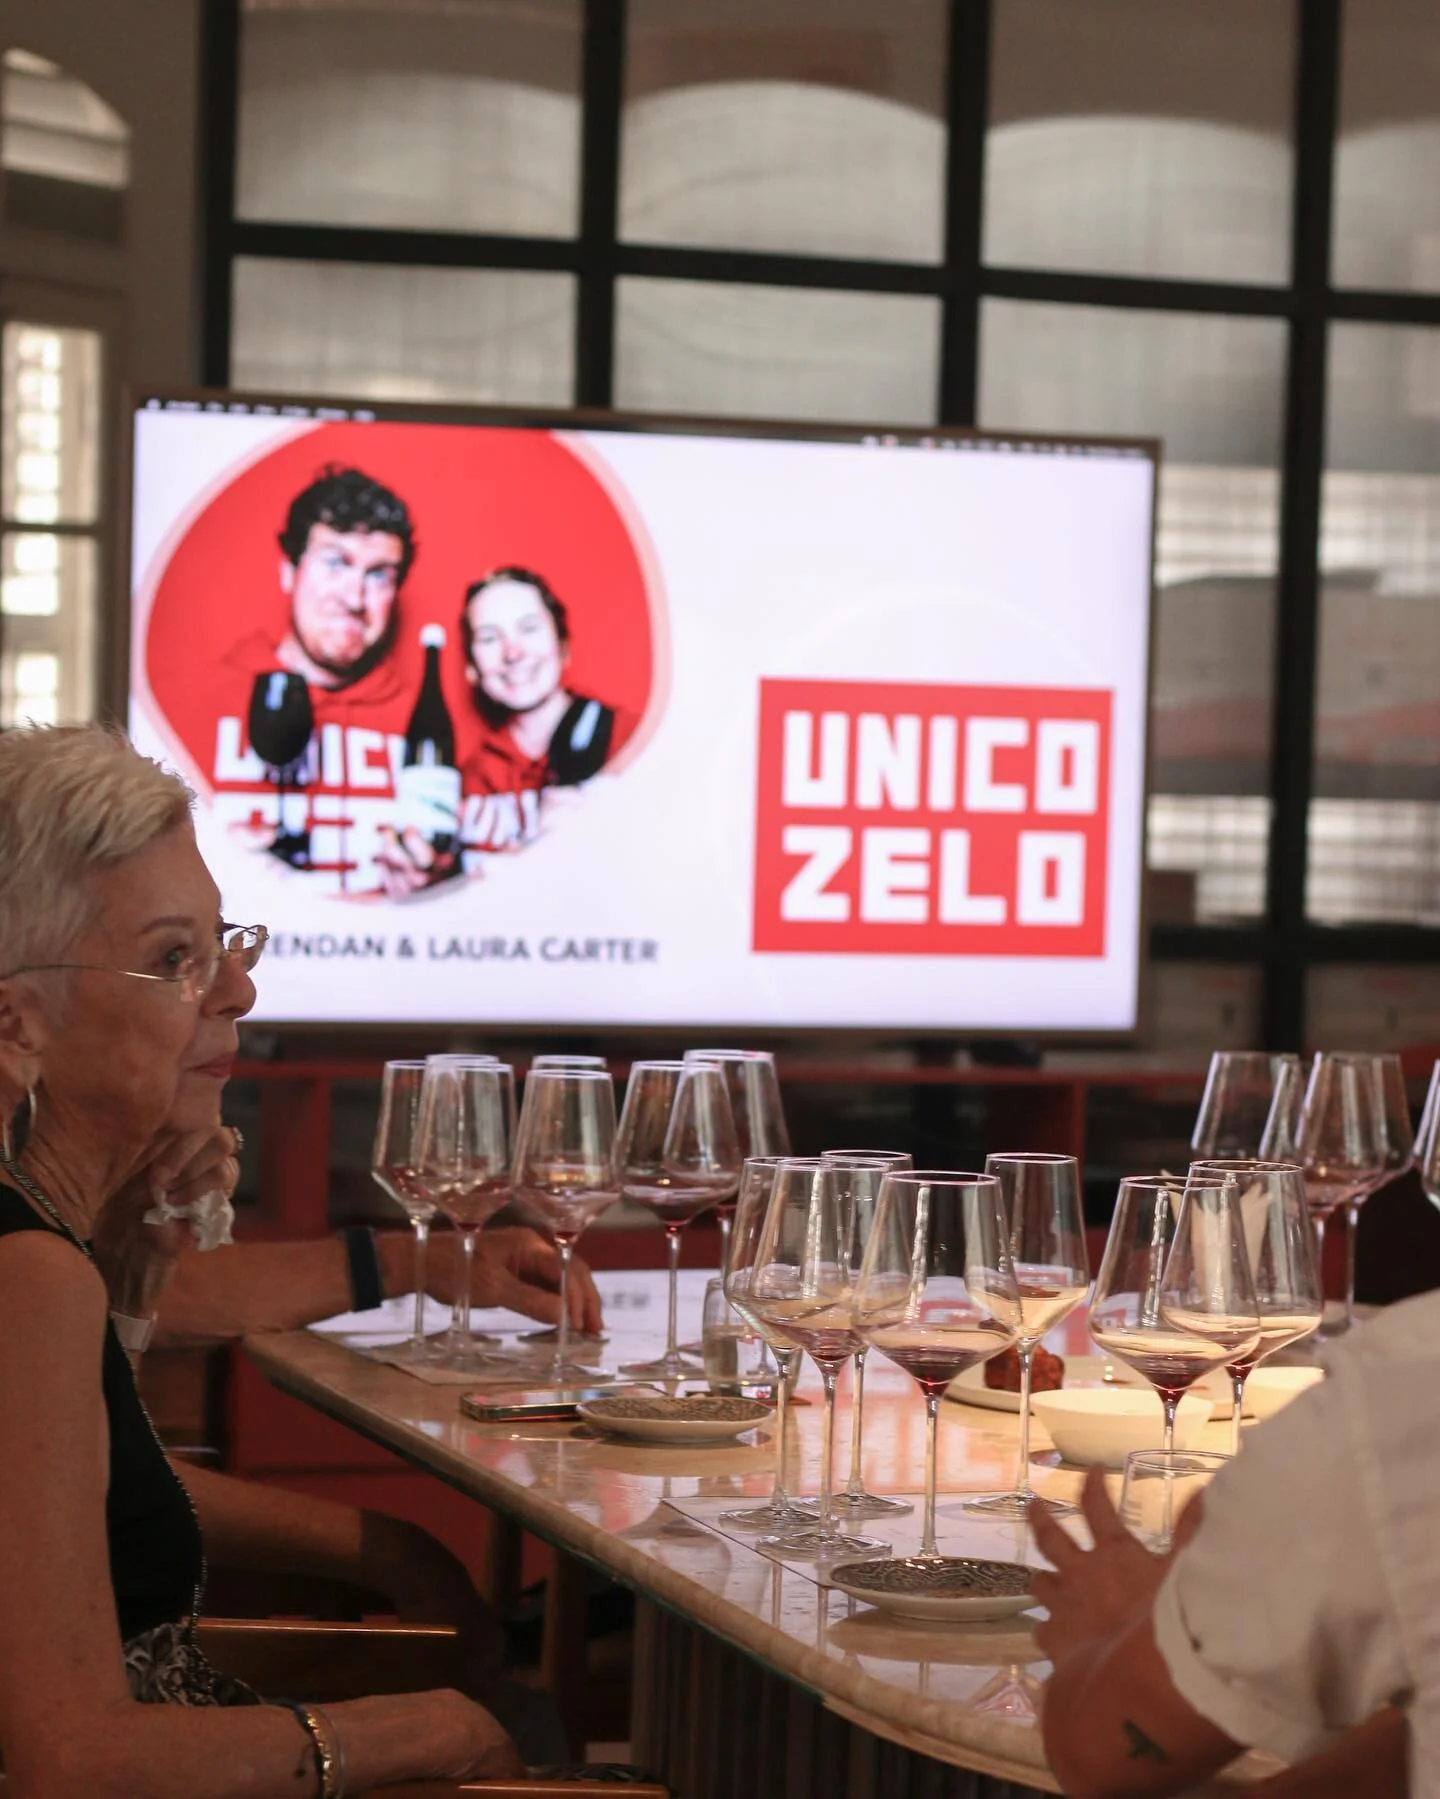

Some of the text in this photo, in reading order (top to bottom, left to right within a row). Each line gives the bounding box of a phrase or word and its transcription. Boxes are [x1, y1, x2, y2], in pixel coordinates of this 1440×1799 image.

[782, 710, 1099, 815] UNICO
[780, 825, 1086, 927] ZELO
[268, 932, 661, 964] ENDAN & LAURA CARTER
